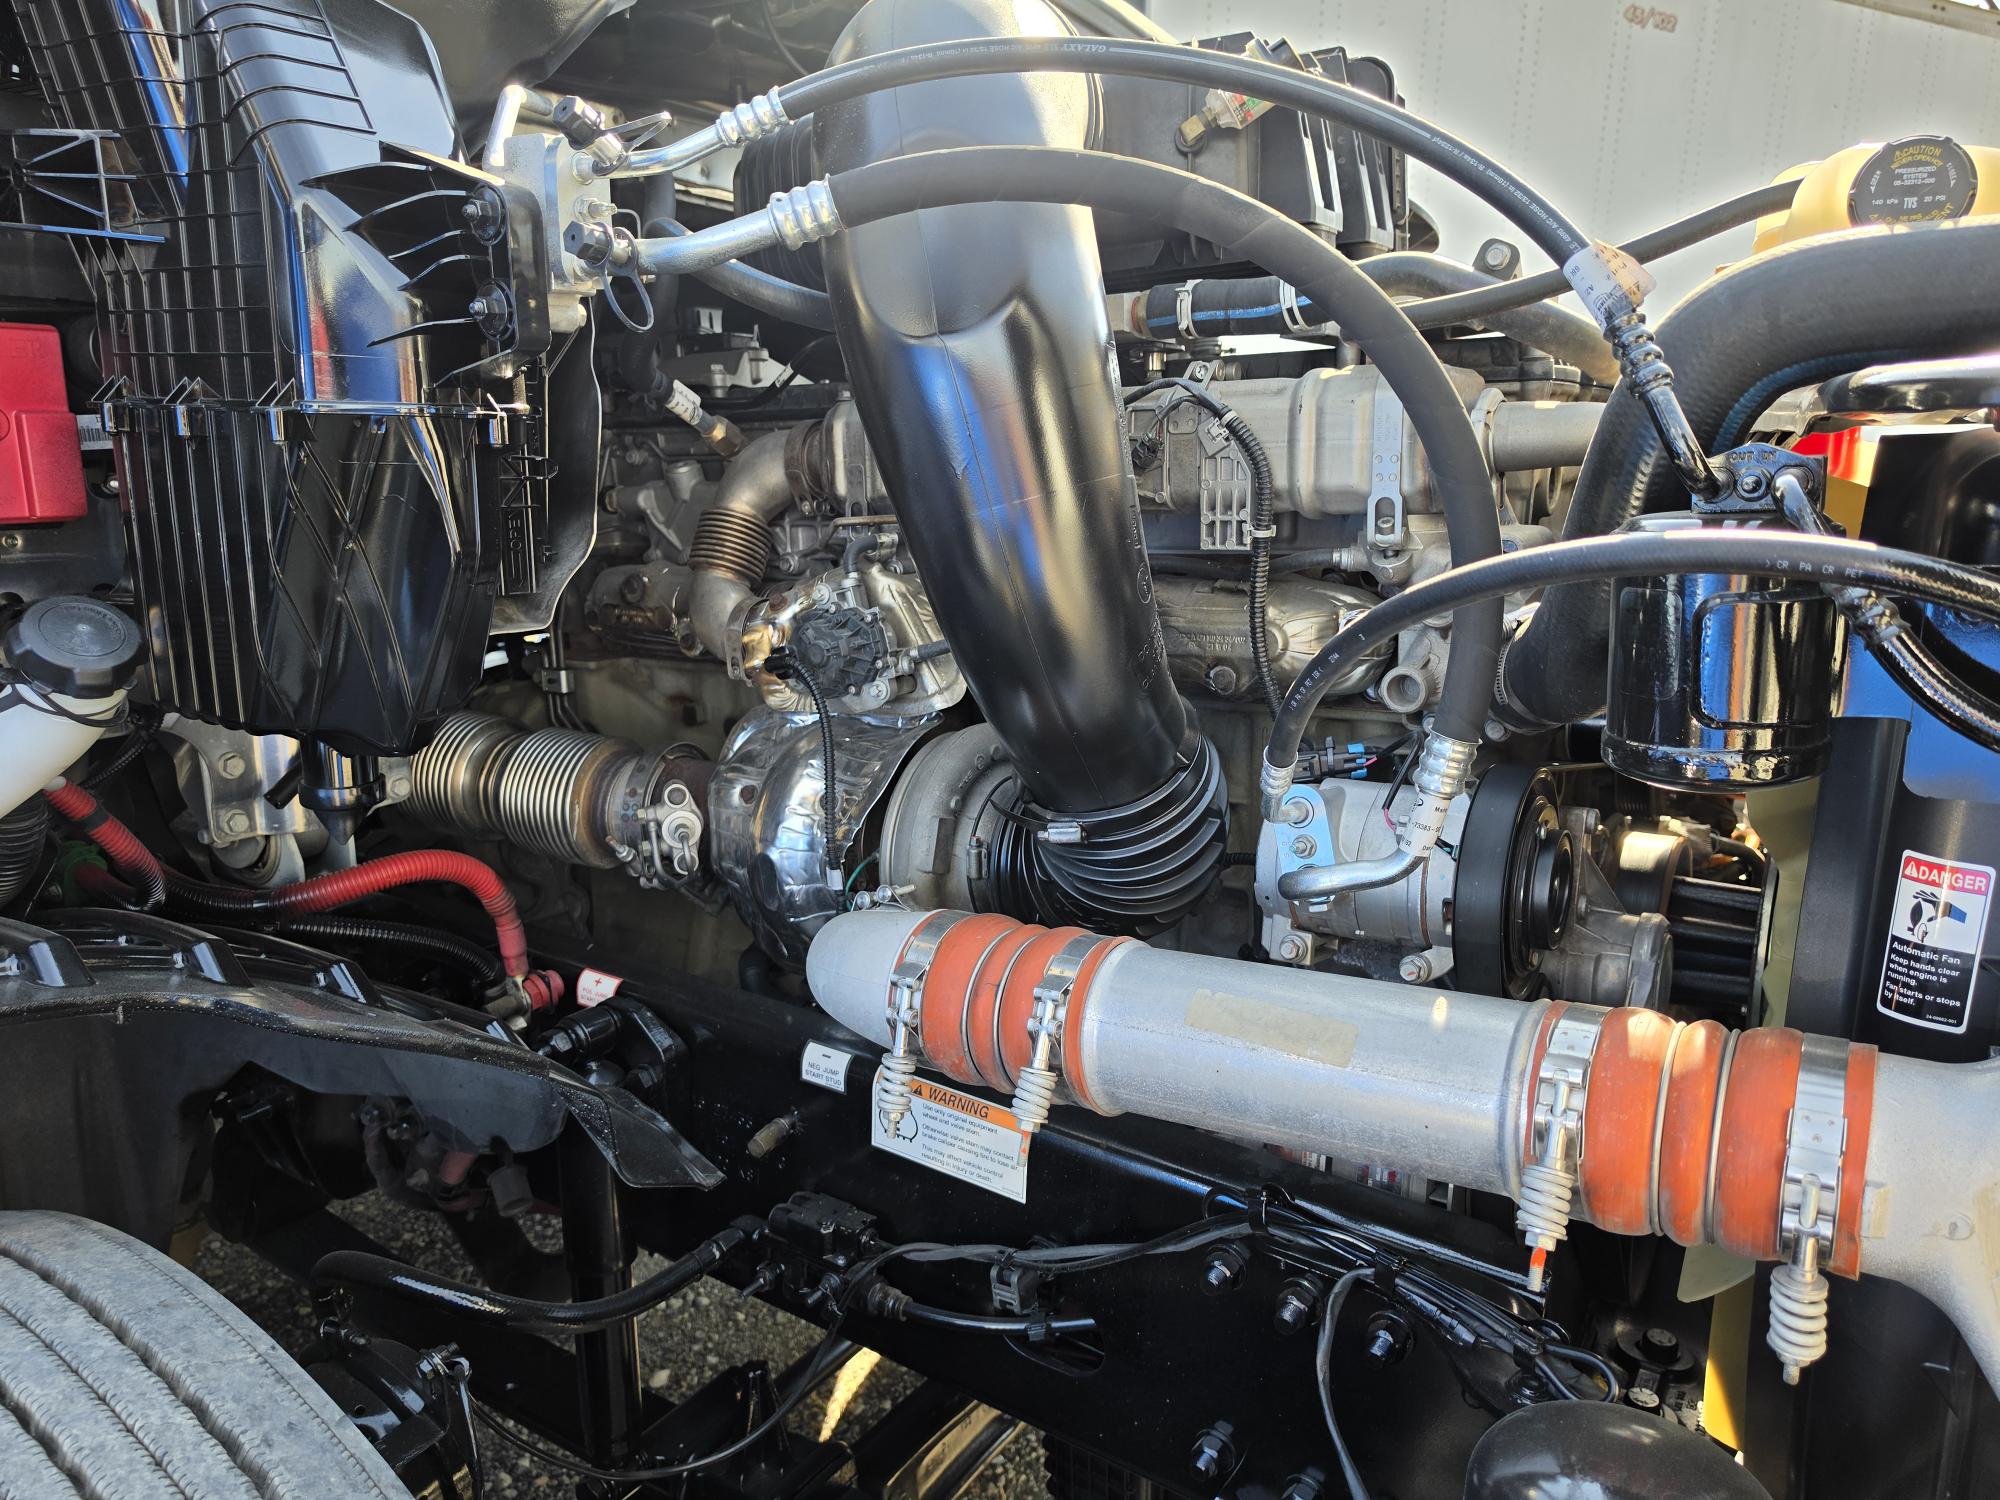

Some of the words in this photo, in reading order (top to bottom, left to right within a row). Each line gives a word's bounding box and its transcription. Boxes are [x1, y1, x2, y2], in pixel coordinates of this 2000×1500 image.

[1060, 43, 1106, 53] GALAXY
[1903, 145, 1942, 157] CAUTION
[1528, 201, 1549, 222] HOSE
[1903, 197, 1918, 209] TVS
[1776, 560, 1789, 569] CR
[1799, 561, 1812, 572] PA
[1822, 564, 1835, 574] CR
[1845, 568, 1864, 578] PET
[1918, 867, 1987, 892] DANGER
[1892, 941, 1939, 961] Automatic
[1941, 954, 1961, 965] Fan
[1889, 962, 1908, 974] when
[1909, 970, 1938, 981] engine
[1890, 953, 1909, 965] Keep
[1910, 959, 1936, 972] hands
[1937, 967, 1961, 977] clear
[1887, 970, 1918, 986] running.
[1884, 989, 1893, 999] by
[1885, 980, 1898, 991] Fan
[1899, 987, 1923, 999] starts
[1924, 993, 1935, 1001] or
[1936, 996, 1961, 1007] stops
[805, 1069, 825, 1080] START
[825, 1075, 842, 1086] STUD
[808, 1061, 821, 1071] NEG
[822, 1066, 840, 1076] JUMP
[928, 1086, 990, 1119] WARNING
[922, 1103, 934, 1112] Use
[934, 1107, 946, 1117] only
[946, 1111, 968, 1124] original
[968, 1119, 998, 1135] equipment
[992, 1149, 1014, 1161] contact
